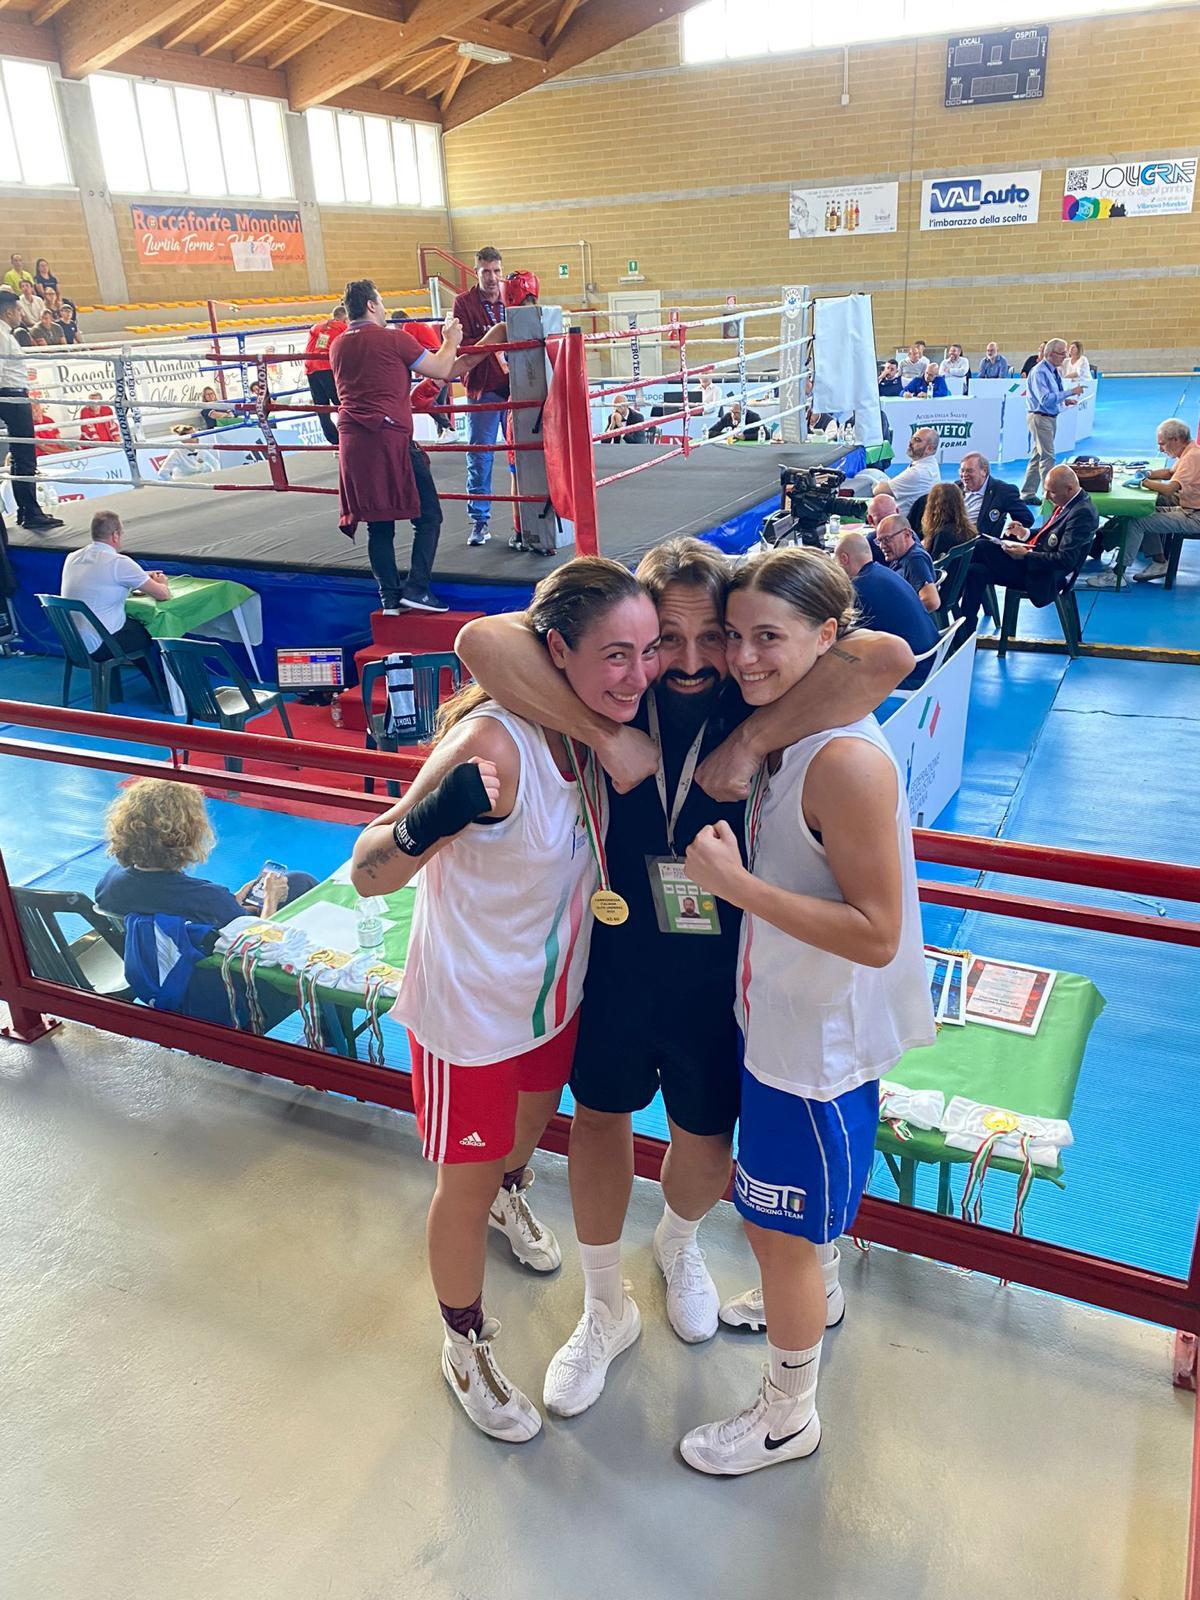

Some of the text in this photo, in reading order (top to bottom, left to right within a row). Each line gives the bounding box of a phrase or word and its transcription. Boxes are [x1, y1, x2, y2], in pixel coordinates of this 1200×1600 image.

[959, 37, 981, 46] LOCALI
[1015, 30, 1037, 39] OSPITI
[132, 208, 232, 231] Roccaforte
[929, 213, 1028, 228] l'imbarazzo della scelta
[181, 233, 216, 254] Terme
[115, 379, 136, 462] VOTTERO TEAM
[397, 817, 417, 850] LEONE
[755, 1205, 783, 1216] BOXING
[784, 1210, 804, 1220] TEAM
